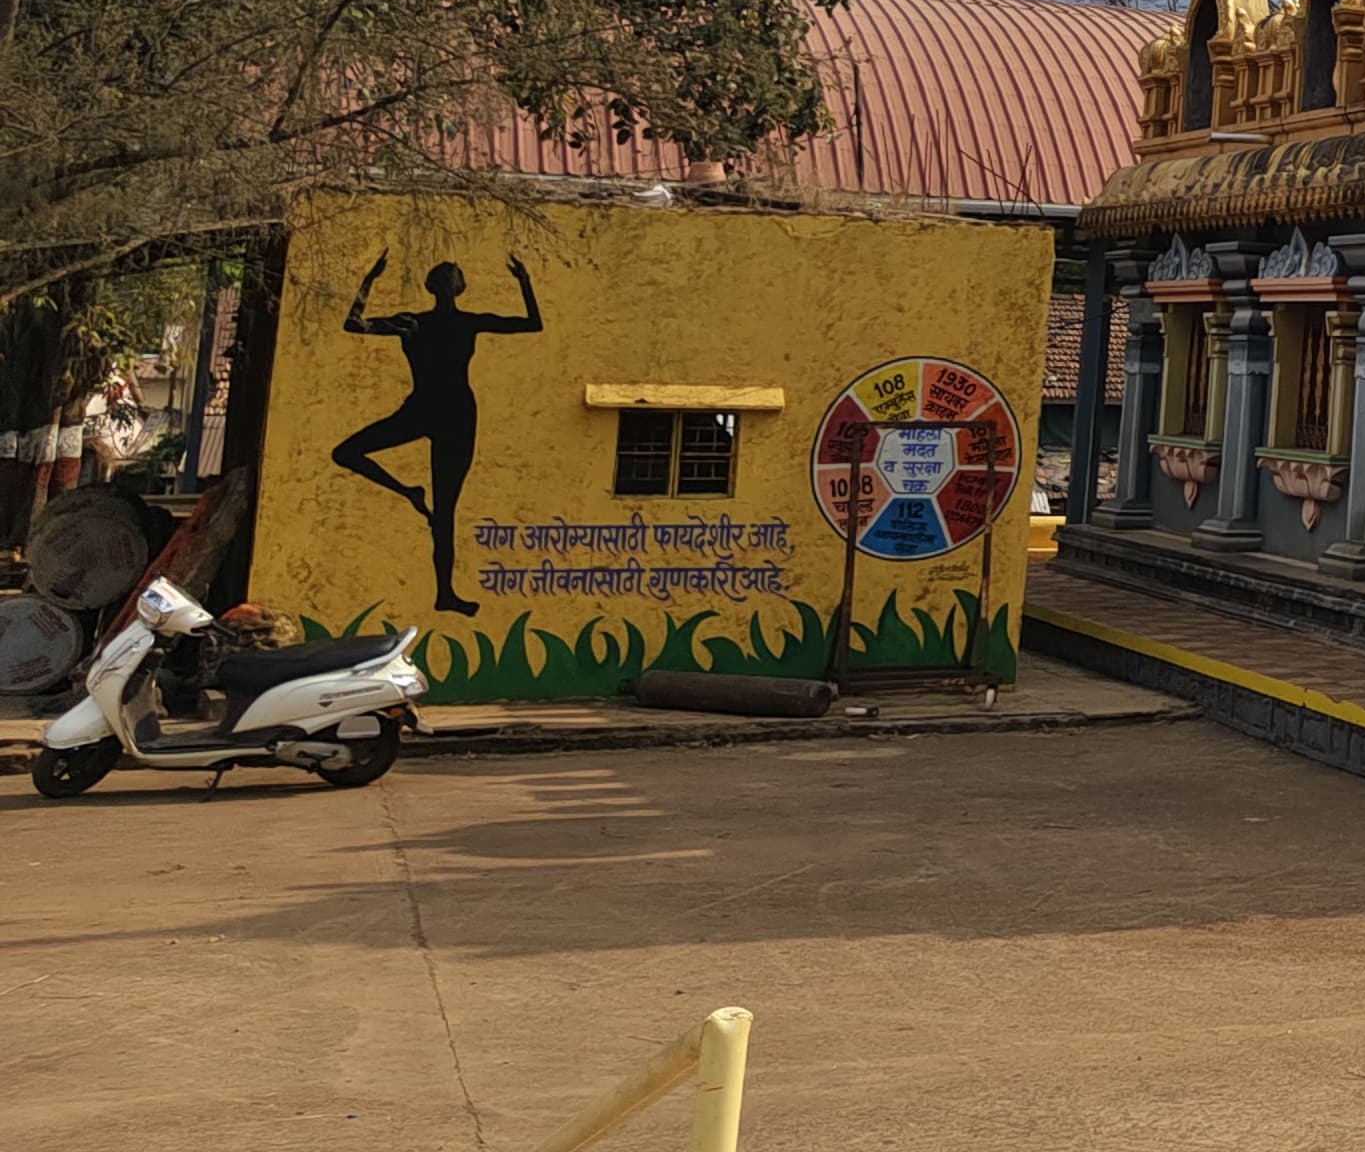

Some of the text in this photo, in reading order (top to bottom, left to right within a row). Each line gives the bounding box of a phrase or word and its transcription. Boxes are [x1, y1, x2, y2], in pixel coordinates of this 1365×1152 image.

[873, 374, 905, 397] 108
[936, 368, 976, 396] 1930
[901, 444, 939, 457] मदत
[884, 461, 944, 478] व सुरक्षा
[829, 475, 873, 497] 108
[898, 502, 924, 518] 112
[474, 517, 518, 551] योग
[520, 512, 649, 557] आरोग्यासाठी
[653, 513, 748, 559] फायदेशीर
[478, 561, 529, 598] योग
[529, 557, 647, 598] जीवनासाठी
